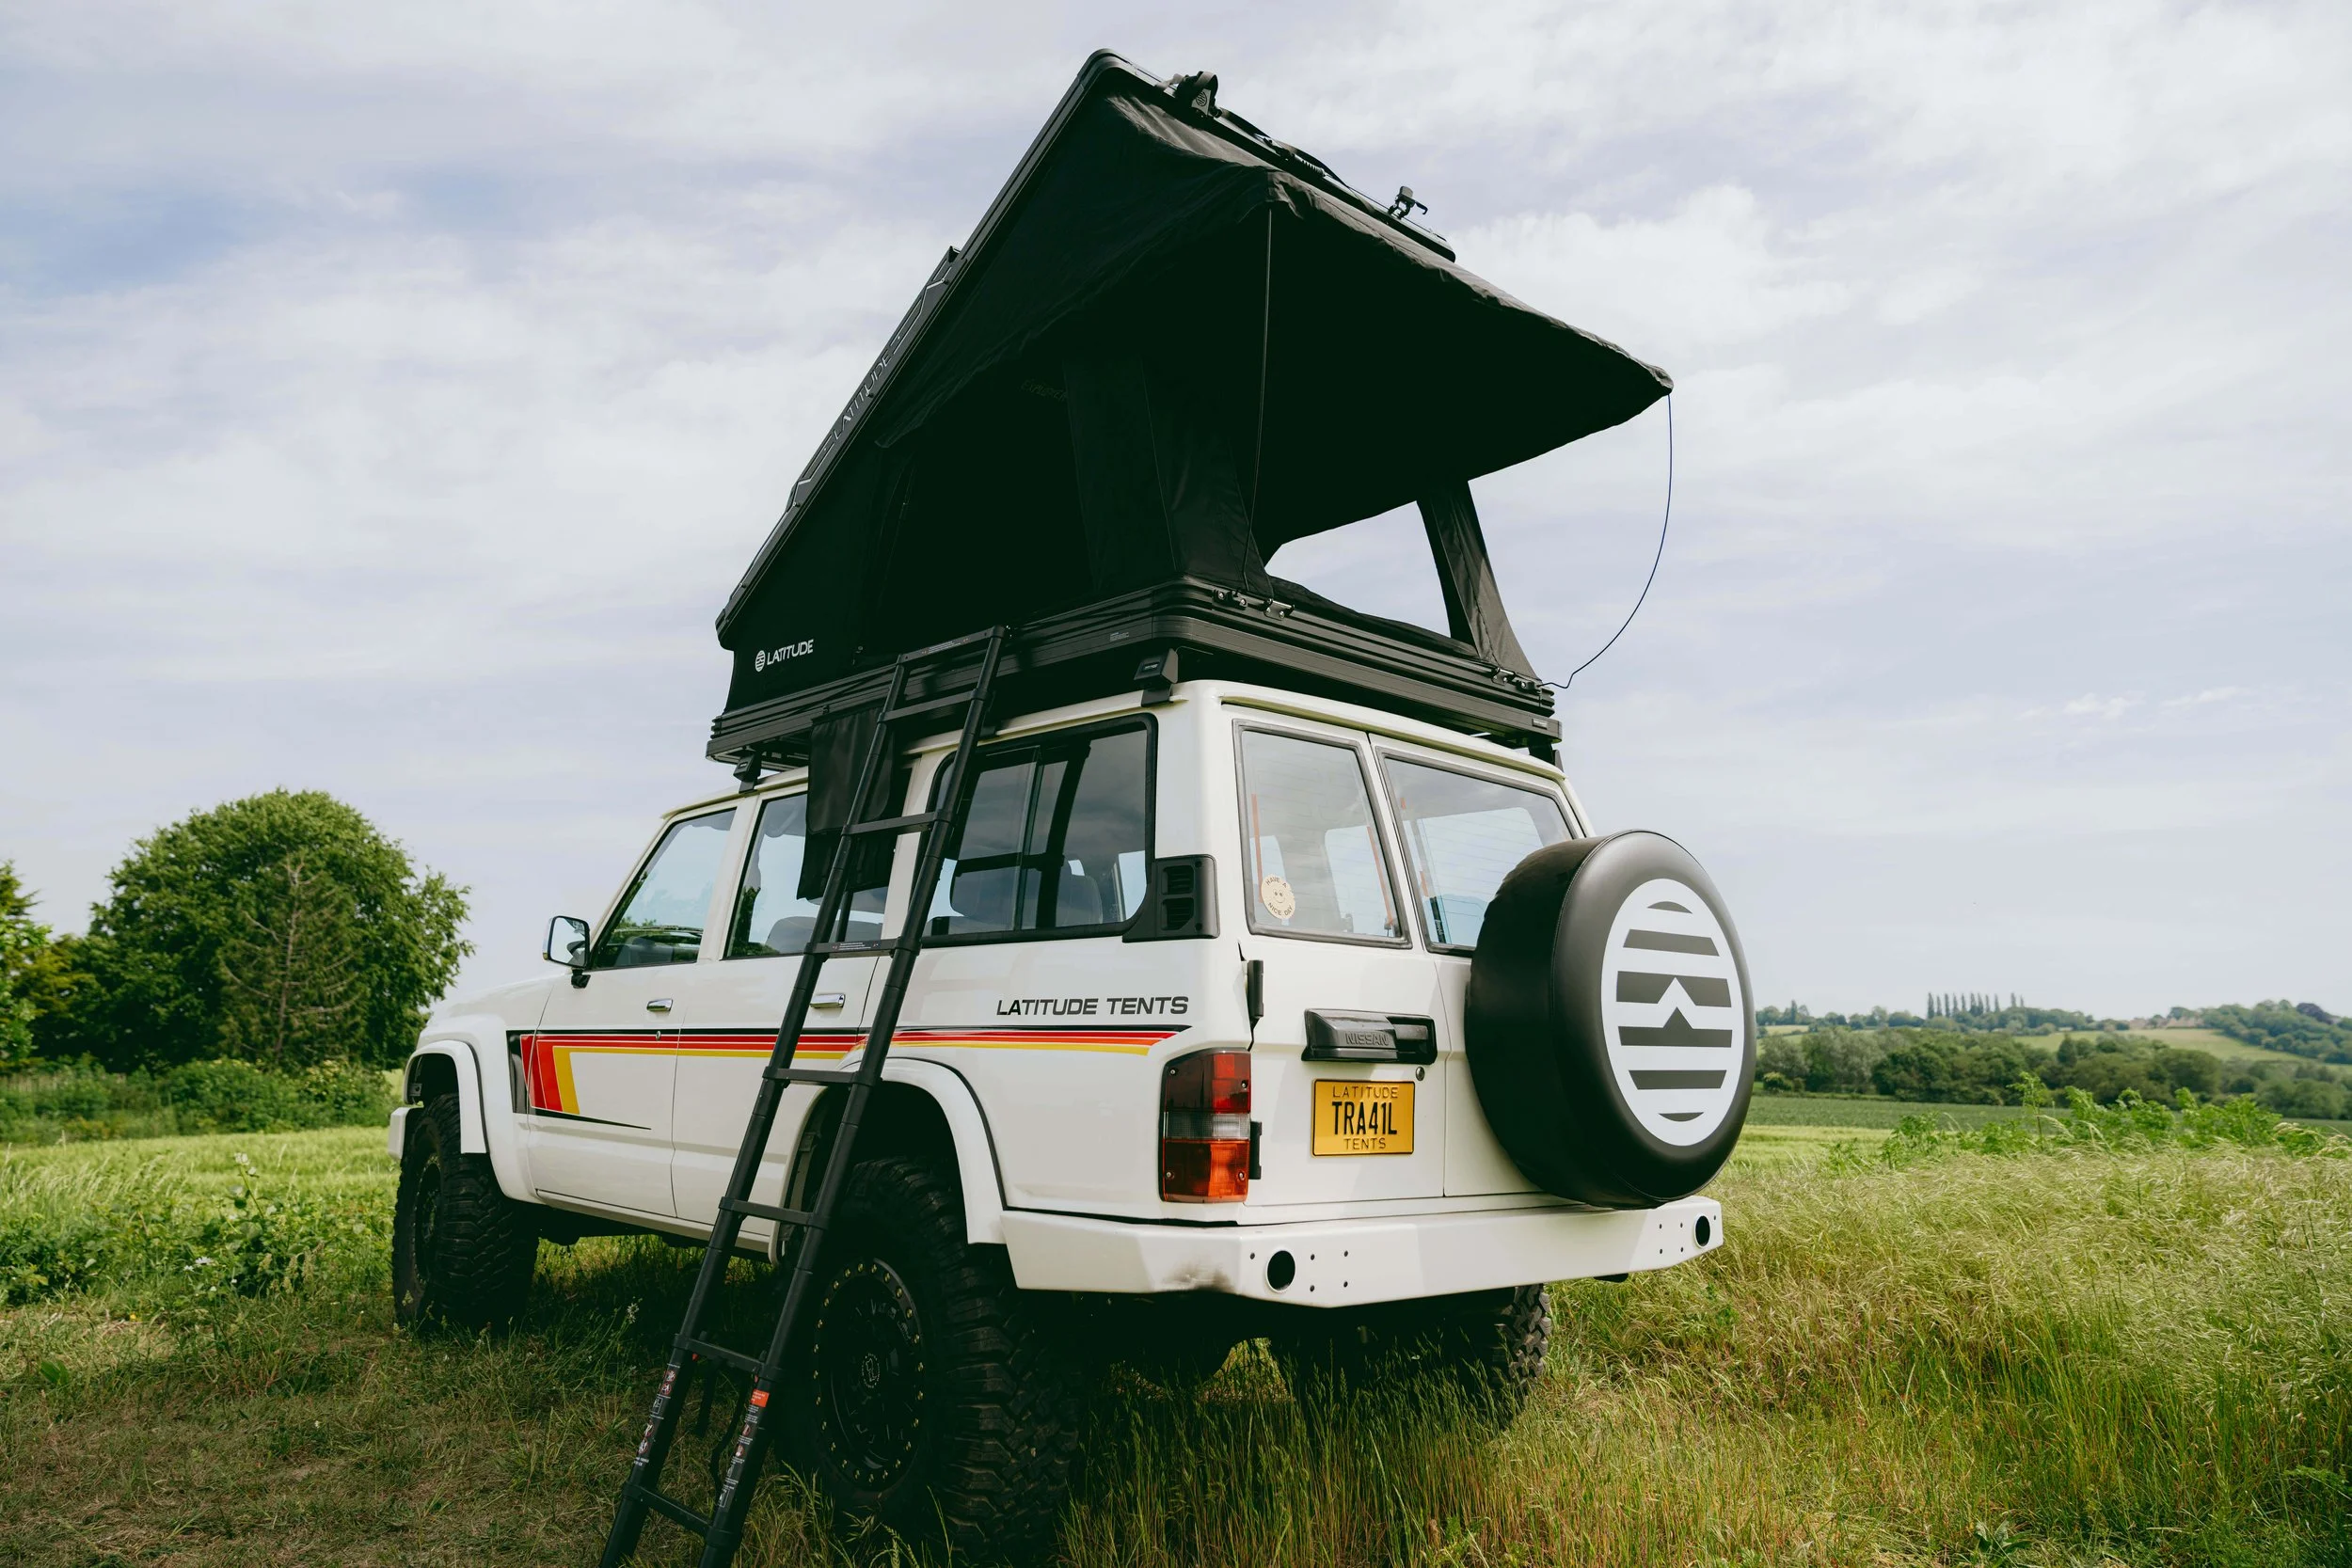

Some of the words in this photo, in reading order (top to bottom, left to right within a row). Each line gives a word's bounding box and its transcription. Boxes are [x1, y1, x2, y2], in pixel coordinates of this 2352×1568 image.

[834, 349, 892, 440] LATITUDE
[767, 639, 814, 665] LATITUDE
[1265, 877, 1280, 886] HAVE
[1268, 902, 1282, 915] NICE
[1284, 905, 1293, 916] DAY
[996, 997, 1099, 1016] LATITUDE
[1106, 995, 1189, 1015] TENTS
[1345, 1032, 1390, 1047] NISSAN
[1332, 1085, 1399, 1099] LATITUDE
[1332, 1101, 1398, 1135] TRA41L
[1343, 1137, 1387, 1150] TENTS
